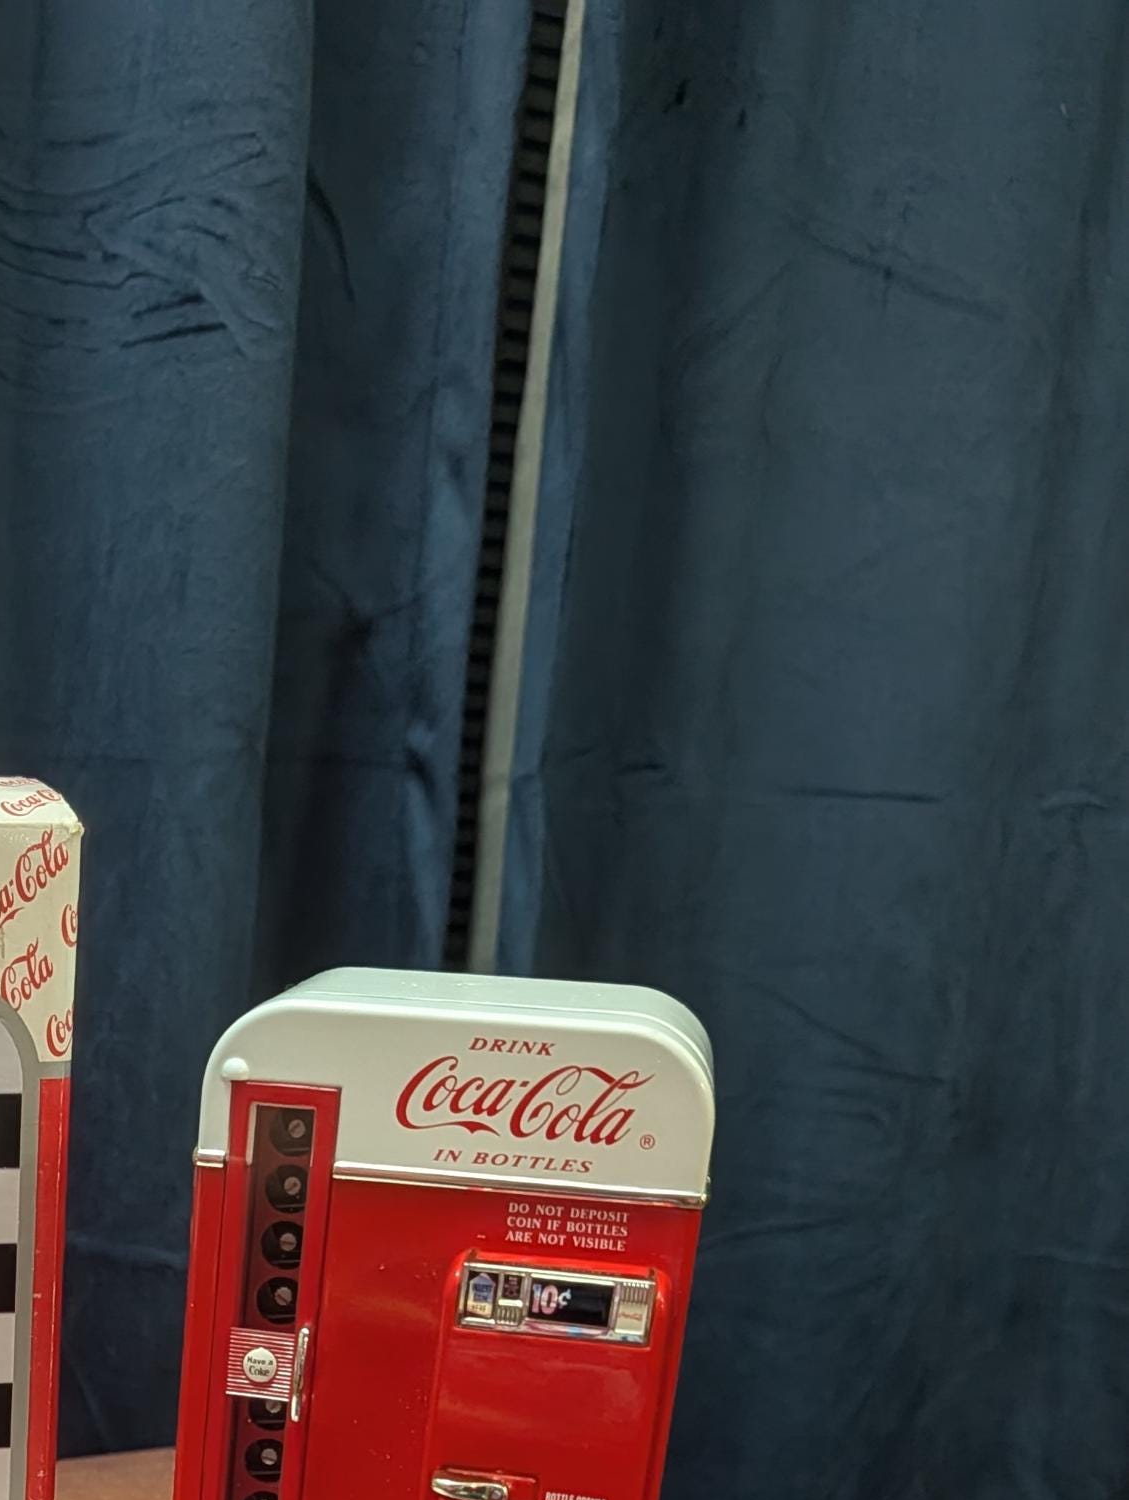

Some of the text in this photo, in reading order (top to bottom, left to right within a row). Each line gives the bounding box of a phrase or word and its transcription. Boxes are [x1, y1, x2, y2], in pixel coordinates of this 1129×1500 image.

[469, 1037, 555, 1056] DRINK
[396, 1055, 655, 1145] Coca-Cola
[433, 1149, 593, 1173] IN BOTTLES
[508, 1203, 630, 1223] DO NOT DEPOSIT
[507, 1217, 628, 1236] COIN IF BOTTLES
[505, 1232, 626, 1251] ARE NOT VISIBLE
[532, 1284, 572, 1315] 10¢
[247, 1357, 266, 1365] Have
[249, 1366, 270, 1376] Coke
